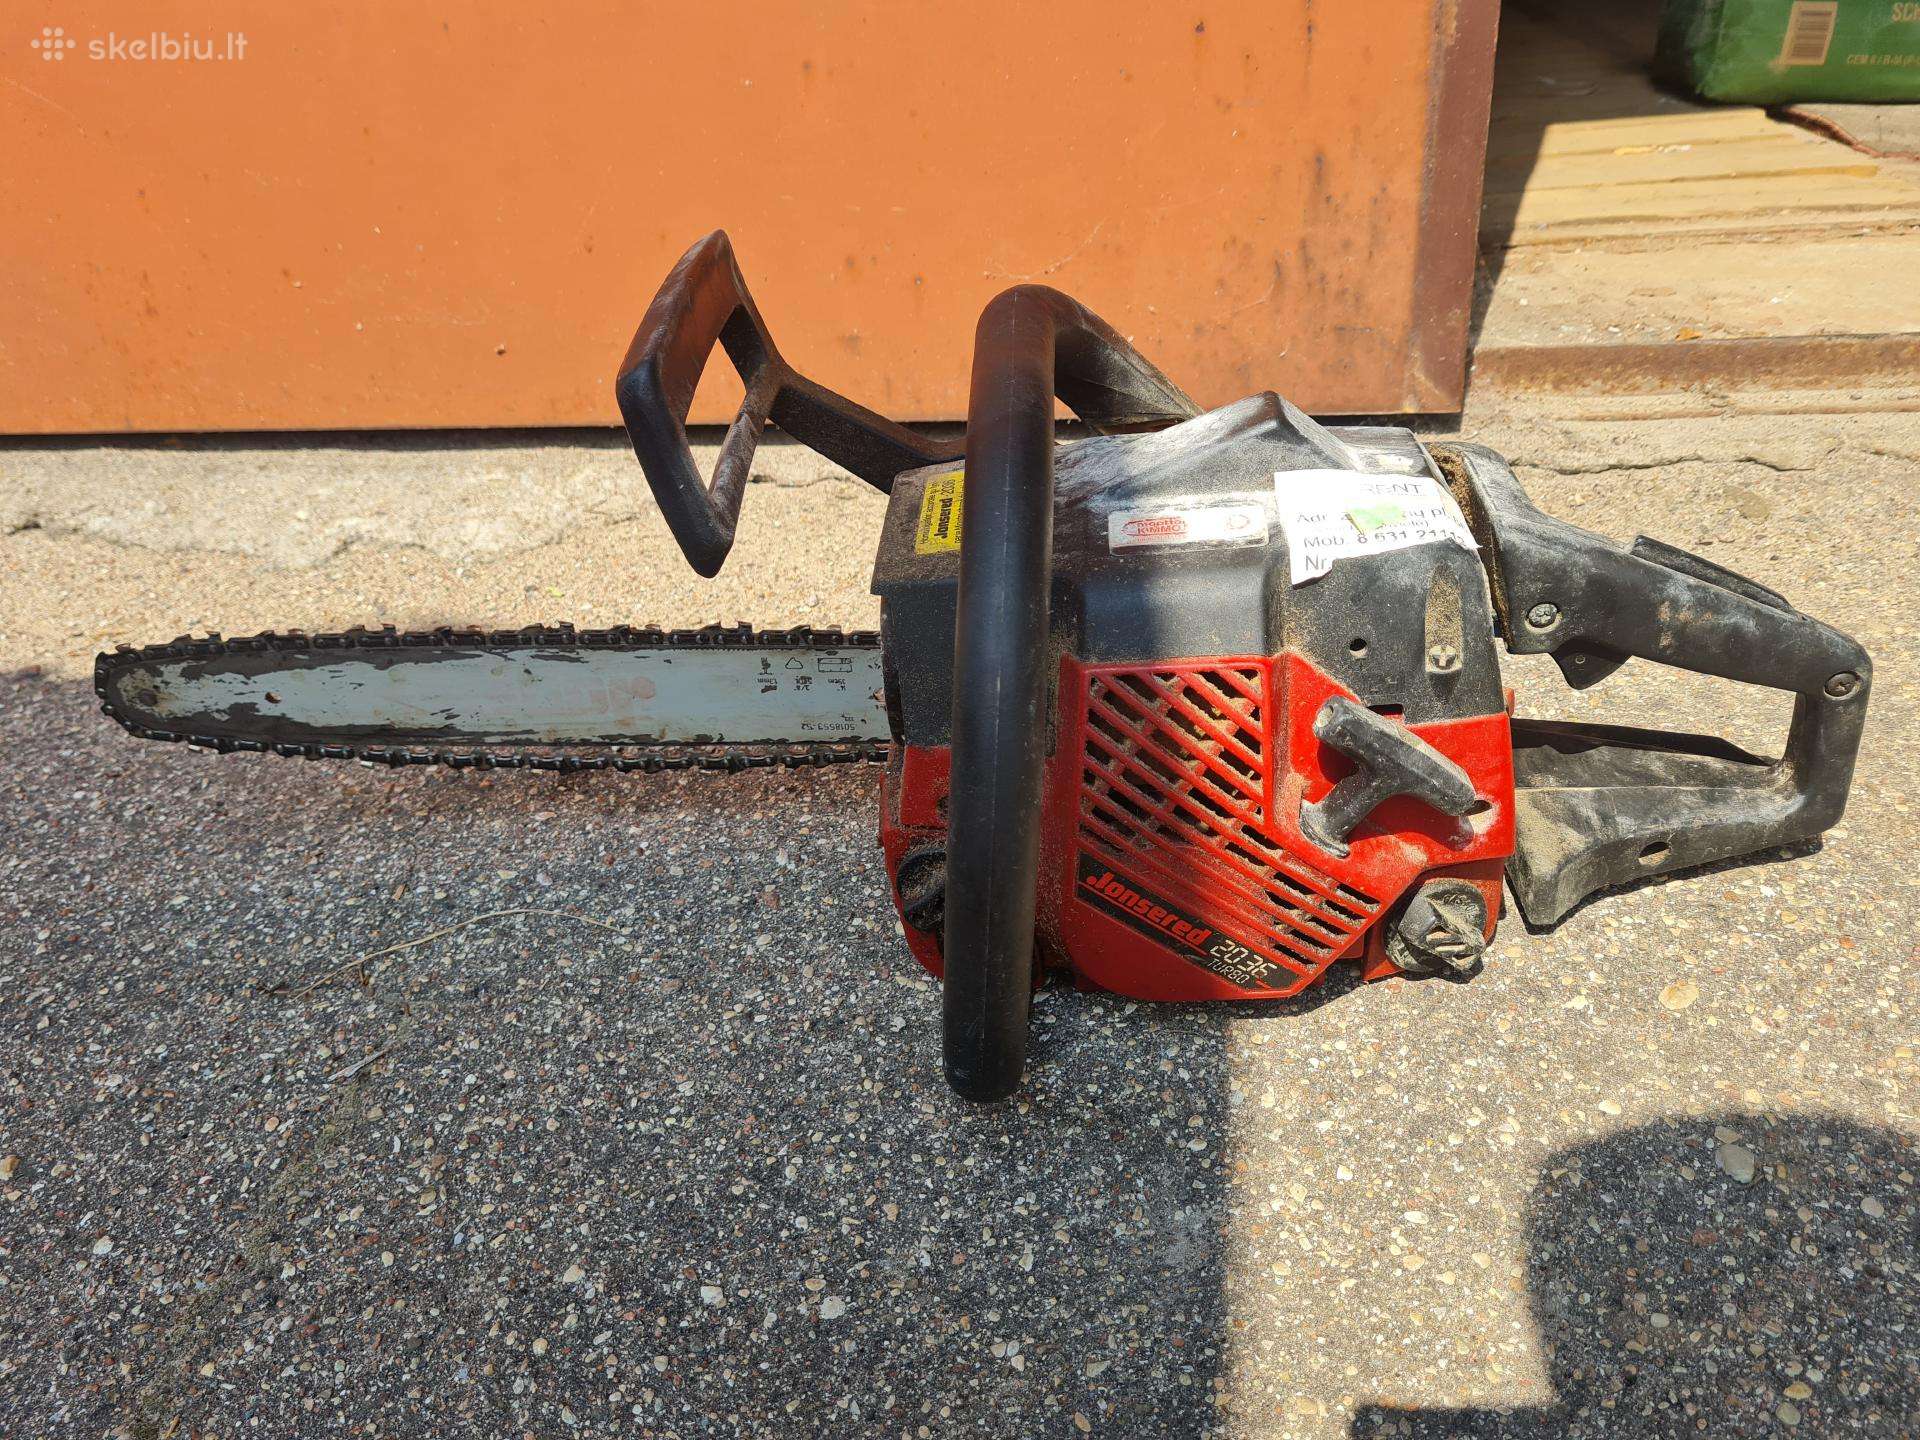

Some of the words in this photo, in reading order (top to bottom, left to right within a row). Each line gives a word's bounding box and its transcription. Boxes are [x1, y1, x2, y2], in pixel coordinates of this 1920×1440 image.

[933, 497, 953, 539] Jonsered
[1086, 871, 1213, 946] Jonsered
[1209, 939, 1278, 977] 2036
[1206, 959, 1251, 984] TURBO
